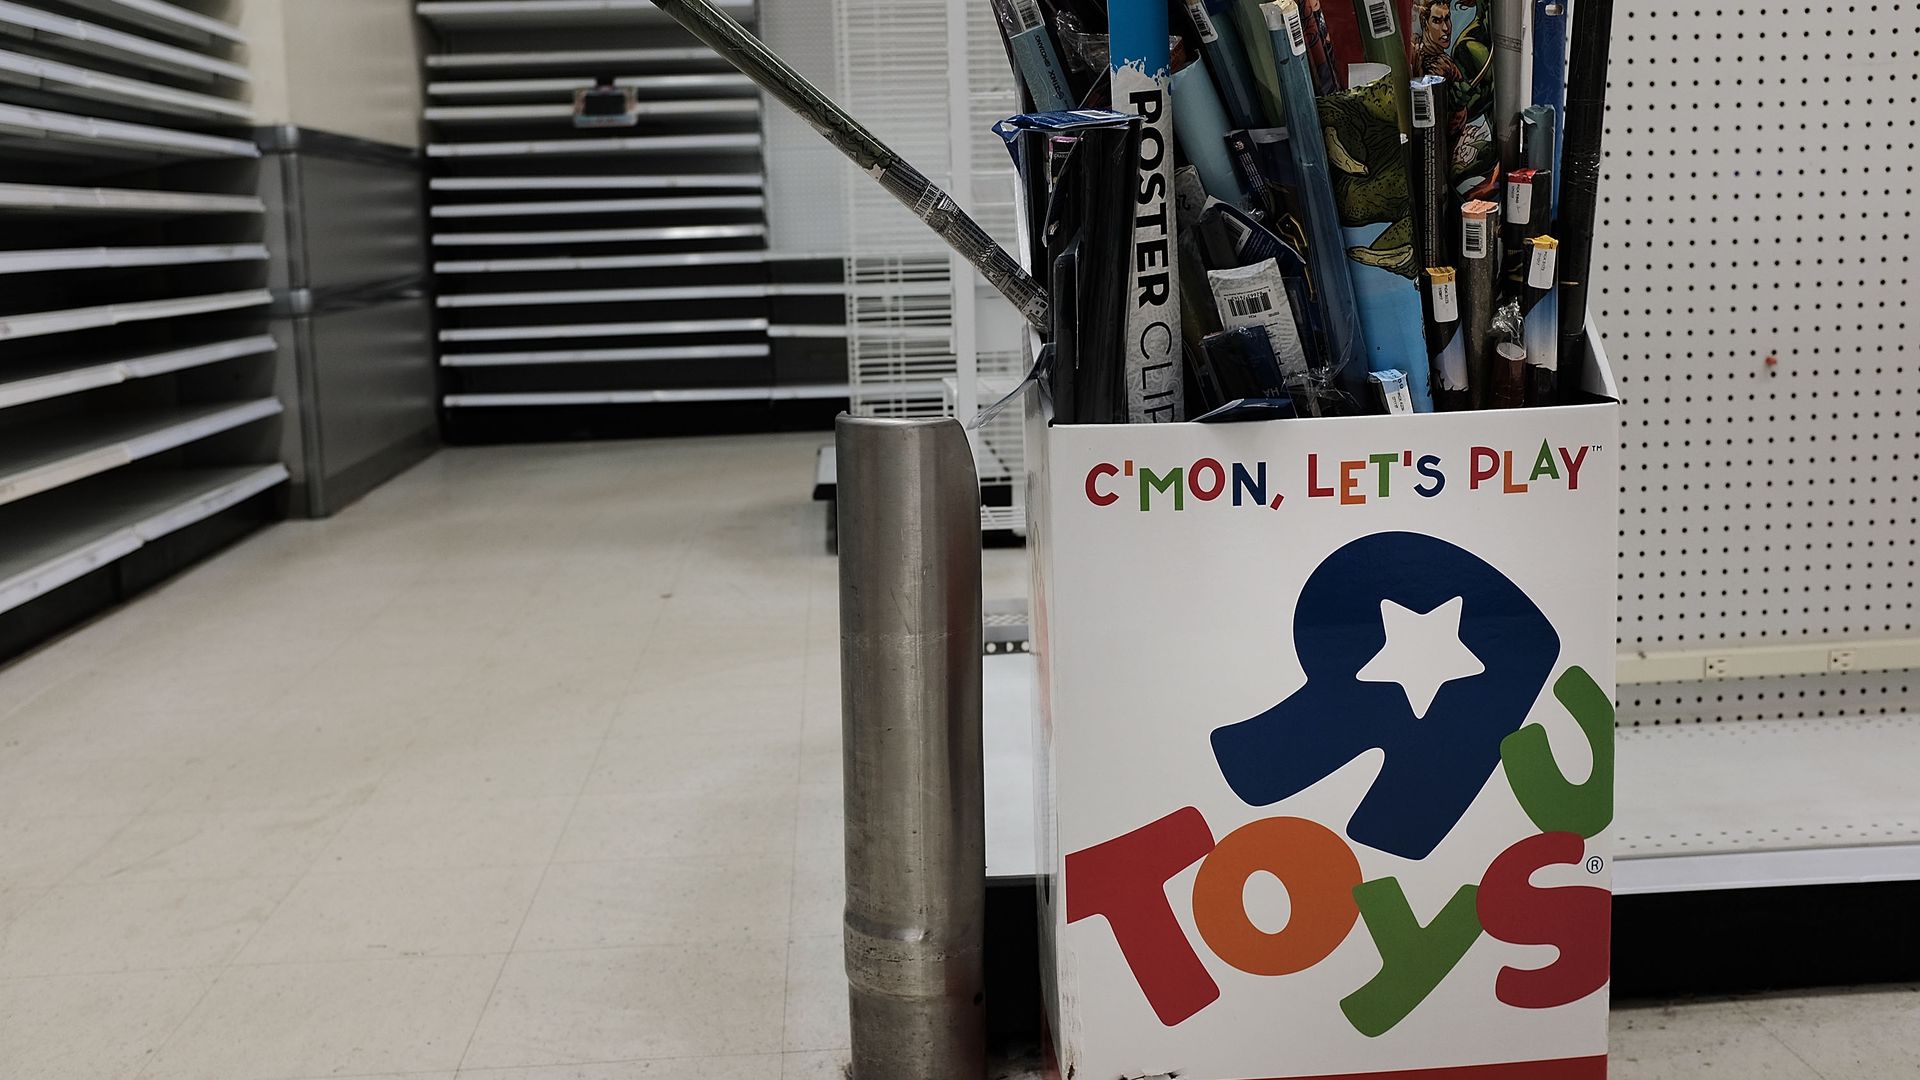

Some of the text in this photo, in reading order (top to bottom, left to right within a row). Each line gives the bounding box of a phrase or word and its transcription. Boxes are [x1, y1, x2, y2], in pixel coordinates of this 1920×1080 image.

[1128, 89, 1170, 308] POSTER
[1085, 458, 1285, 512] C'MON,
[1308, 450, 1446, 505] LET'S
